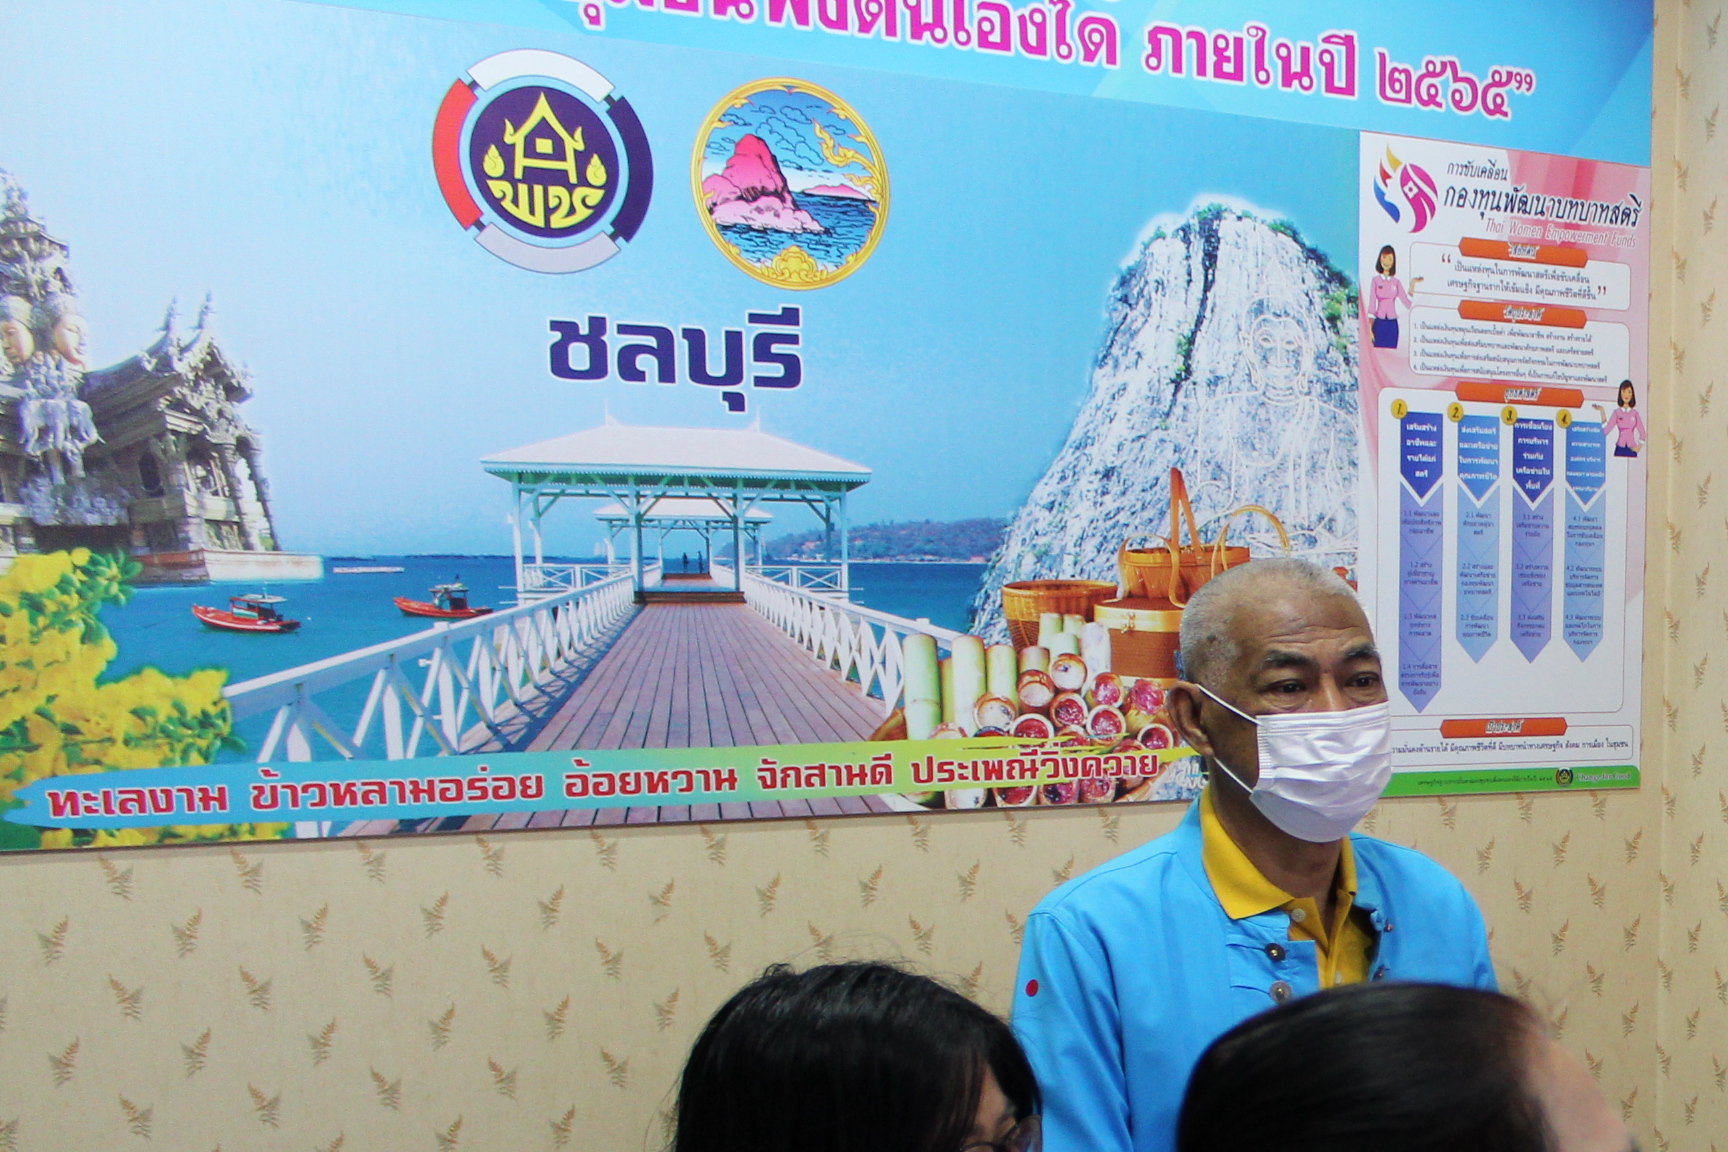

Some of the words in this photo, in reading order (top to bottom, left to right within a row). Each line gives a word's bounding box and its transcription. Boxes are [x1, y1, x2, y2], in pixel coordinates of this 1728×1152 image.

[1144, 25, 1357, 97] ภายในปี
[1447, 159, 1508, 181] การขับเคลื่อน
[1443, 184, 1642, 228] กองทุนพัฒนาบทบาทสตรี
[1486, 218, 1504, 233] Thai
[1509, 221, 1542, 237] Women
[1546, 224, 1608, 245] Empowerment
[1611, 232, 1636, 247] Funds
[549, 305, 802, 412] ชลบุรี
[48, 783, 228, 818] ทะเลงาม
[250, 766, 544, 811] ข้าวหลามอร่อย
[564, 757, 738, 798] อ้อยหวาน
[757, 753, 893, 790] จักสานดี
[911, 742, 1158, 783] ประเพณีวิ่งควาย
